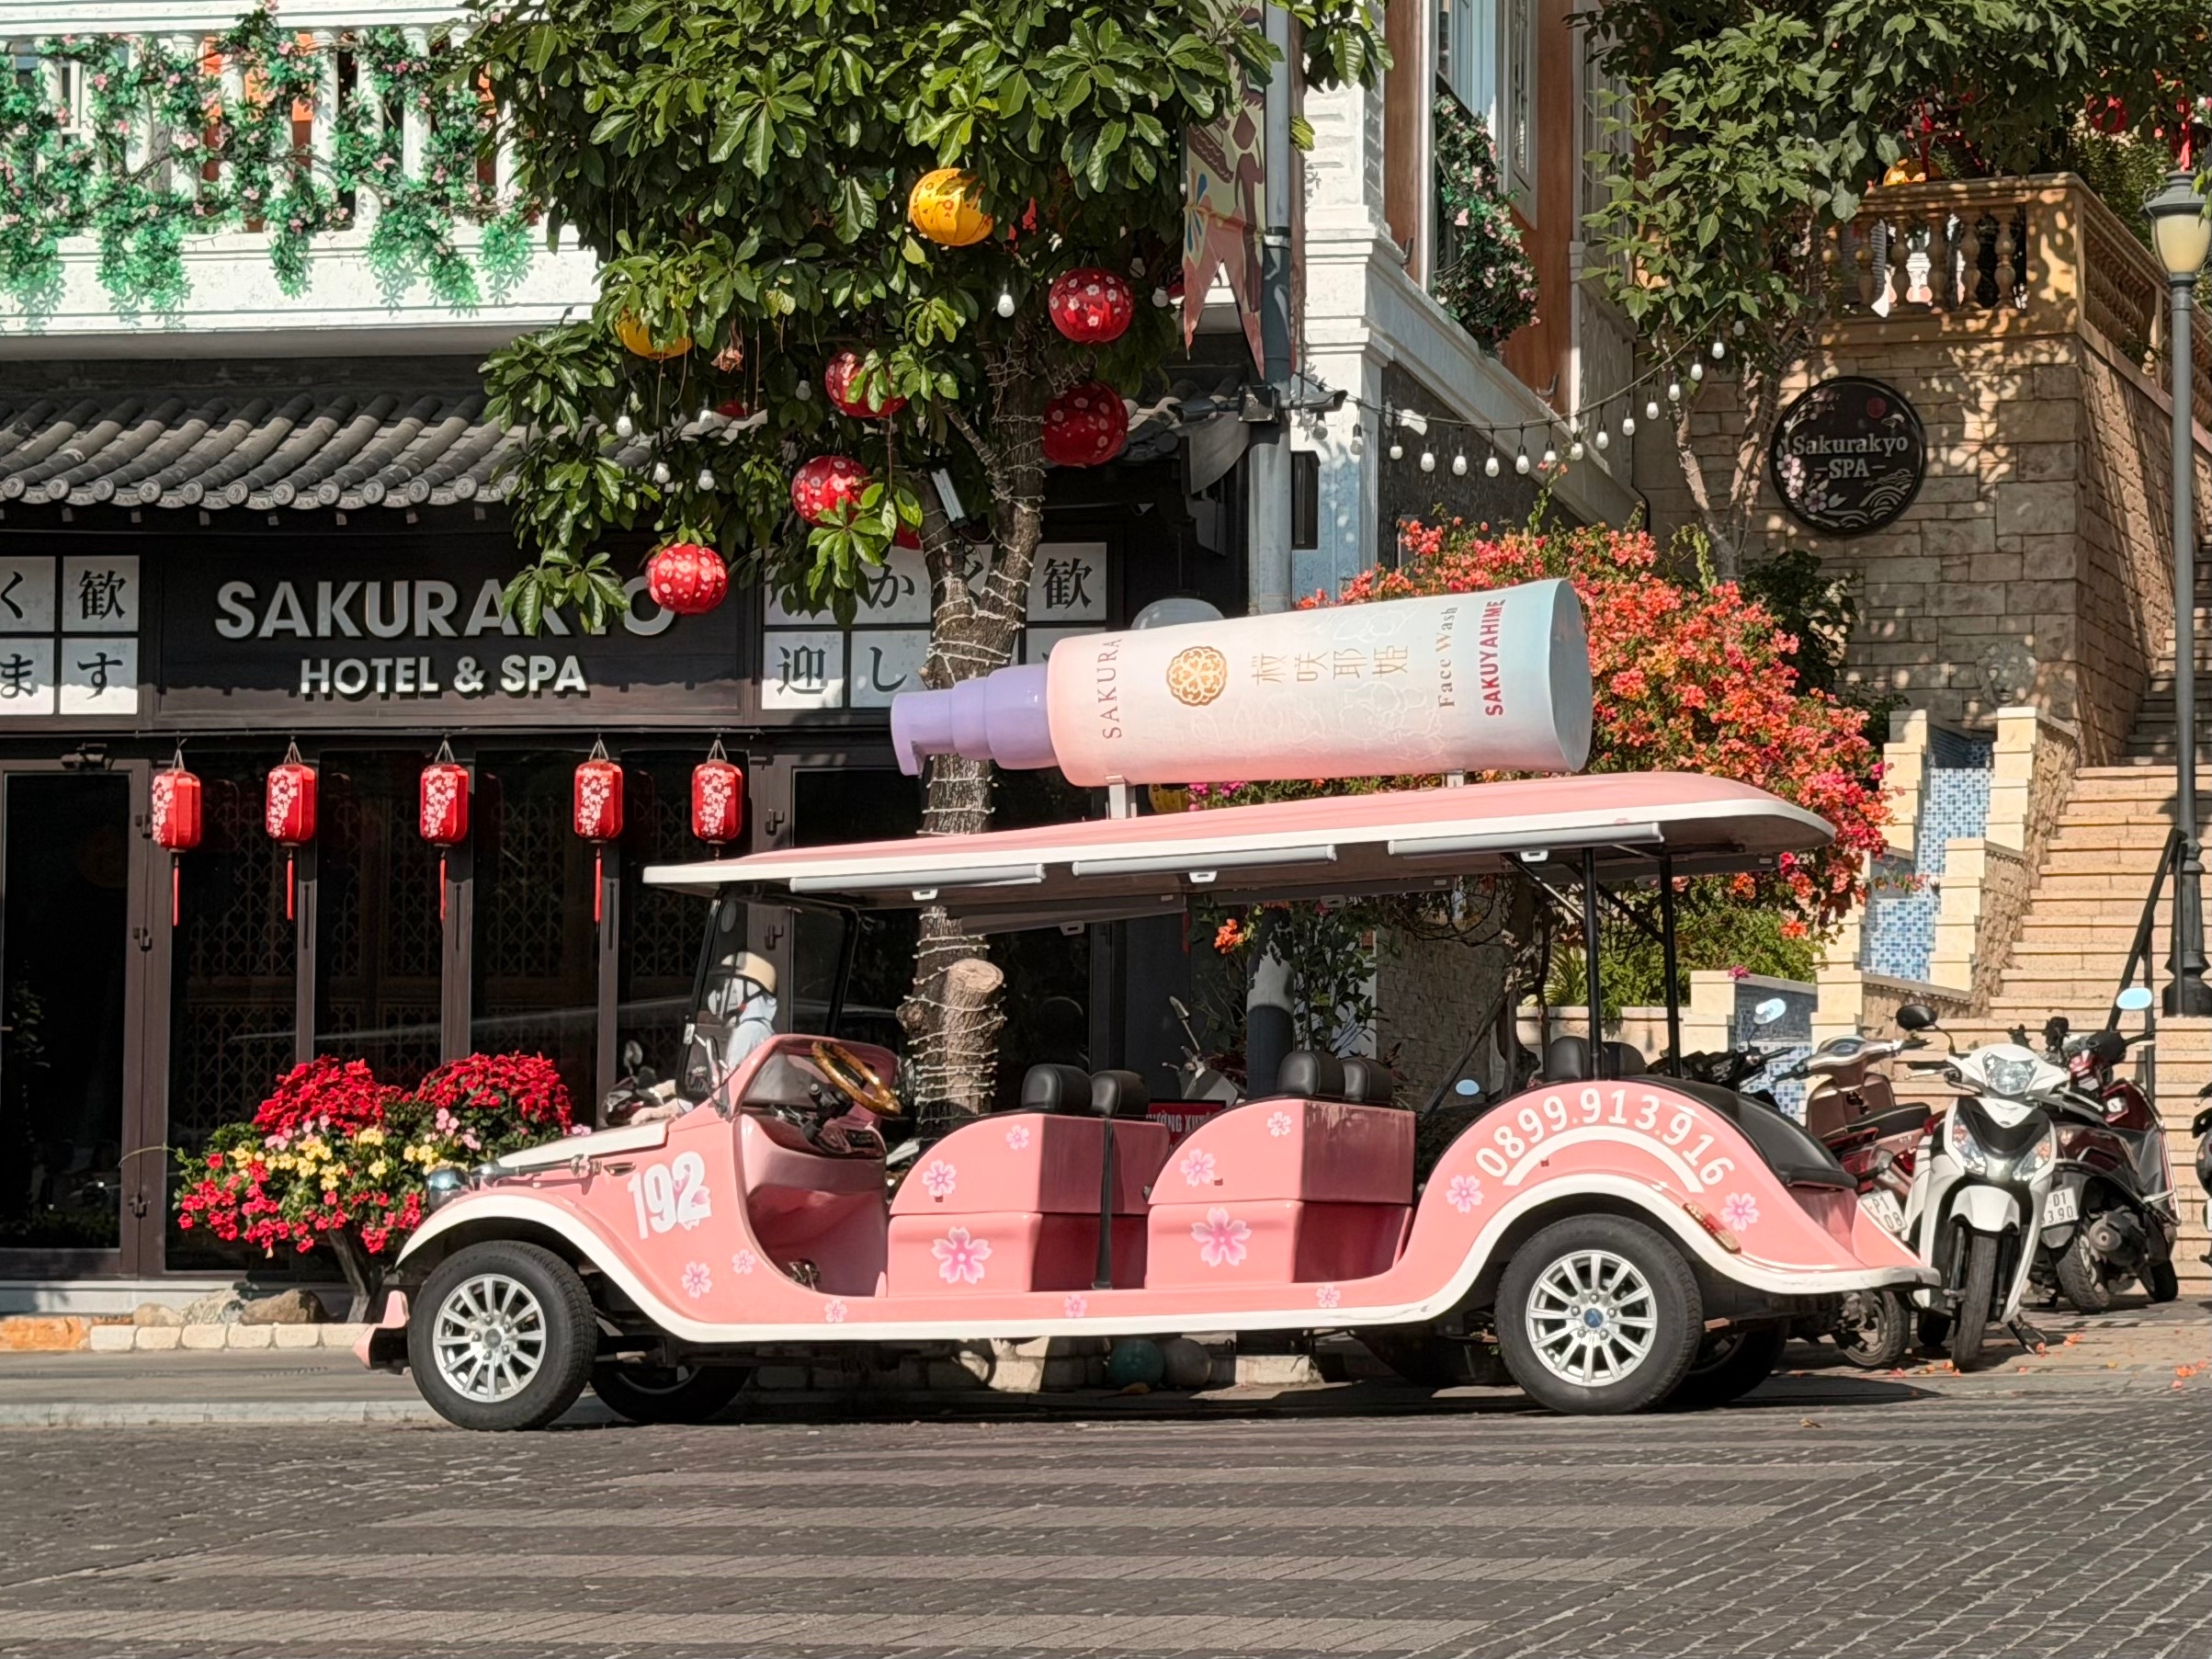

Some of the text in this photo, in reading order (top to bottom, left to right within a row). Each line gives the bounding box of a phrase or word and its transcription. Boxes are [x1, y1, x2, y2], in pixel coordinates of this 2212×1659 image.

[1792, 433, 1909, 457] Sakurakyo
[215, 578, 676, 638] SAKURAO
[301, 654, 589, 694] HOTEL & SPA
[1096, 638, 1123, 739] SAKURA
[1435, 607, 1458, 708] Face Wash
[1480, 599, 1506, 716] SAKUYAHIME
[1475, 1088, 1735, 1186] 0899.913.916
[628, 1151, 712, 1239] 192
